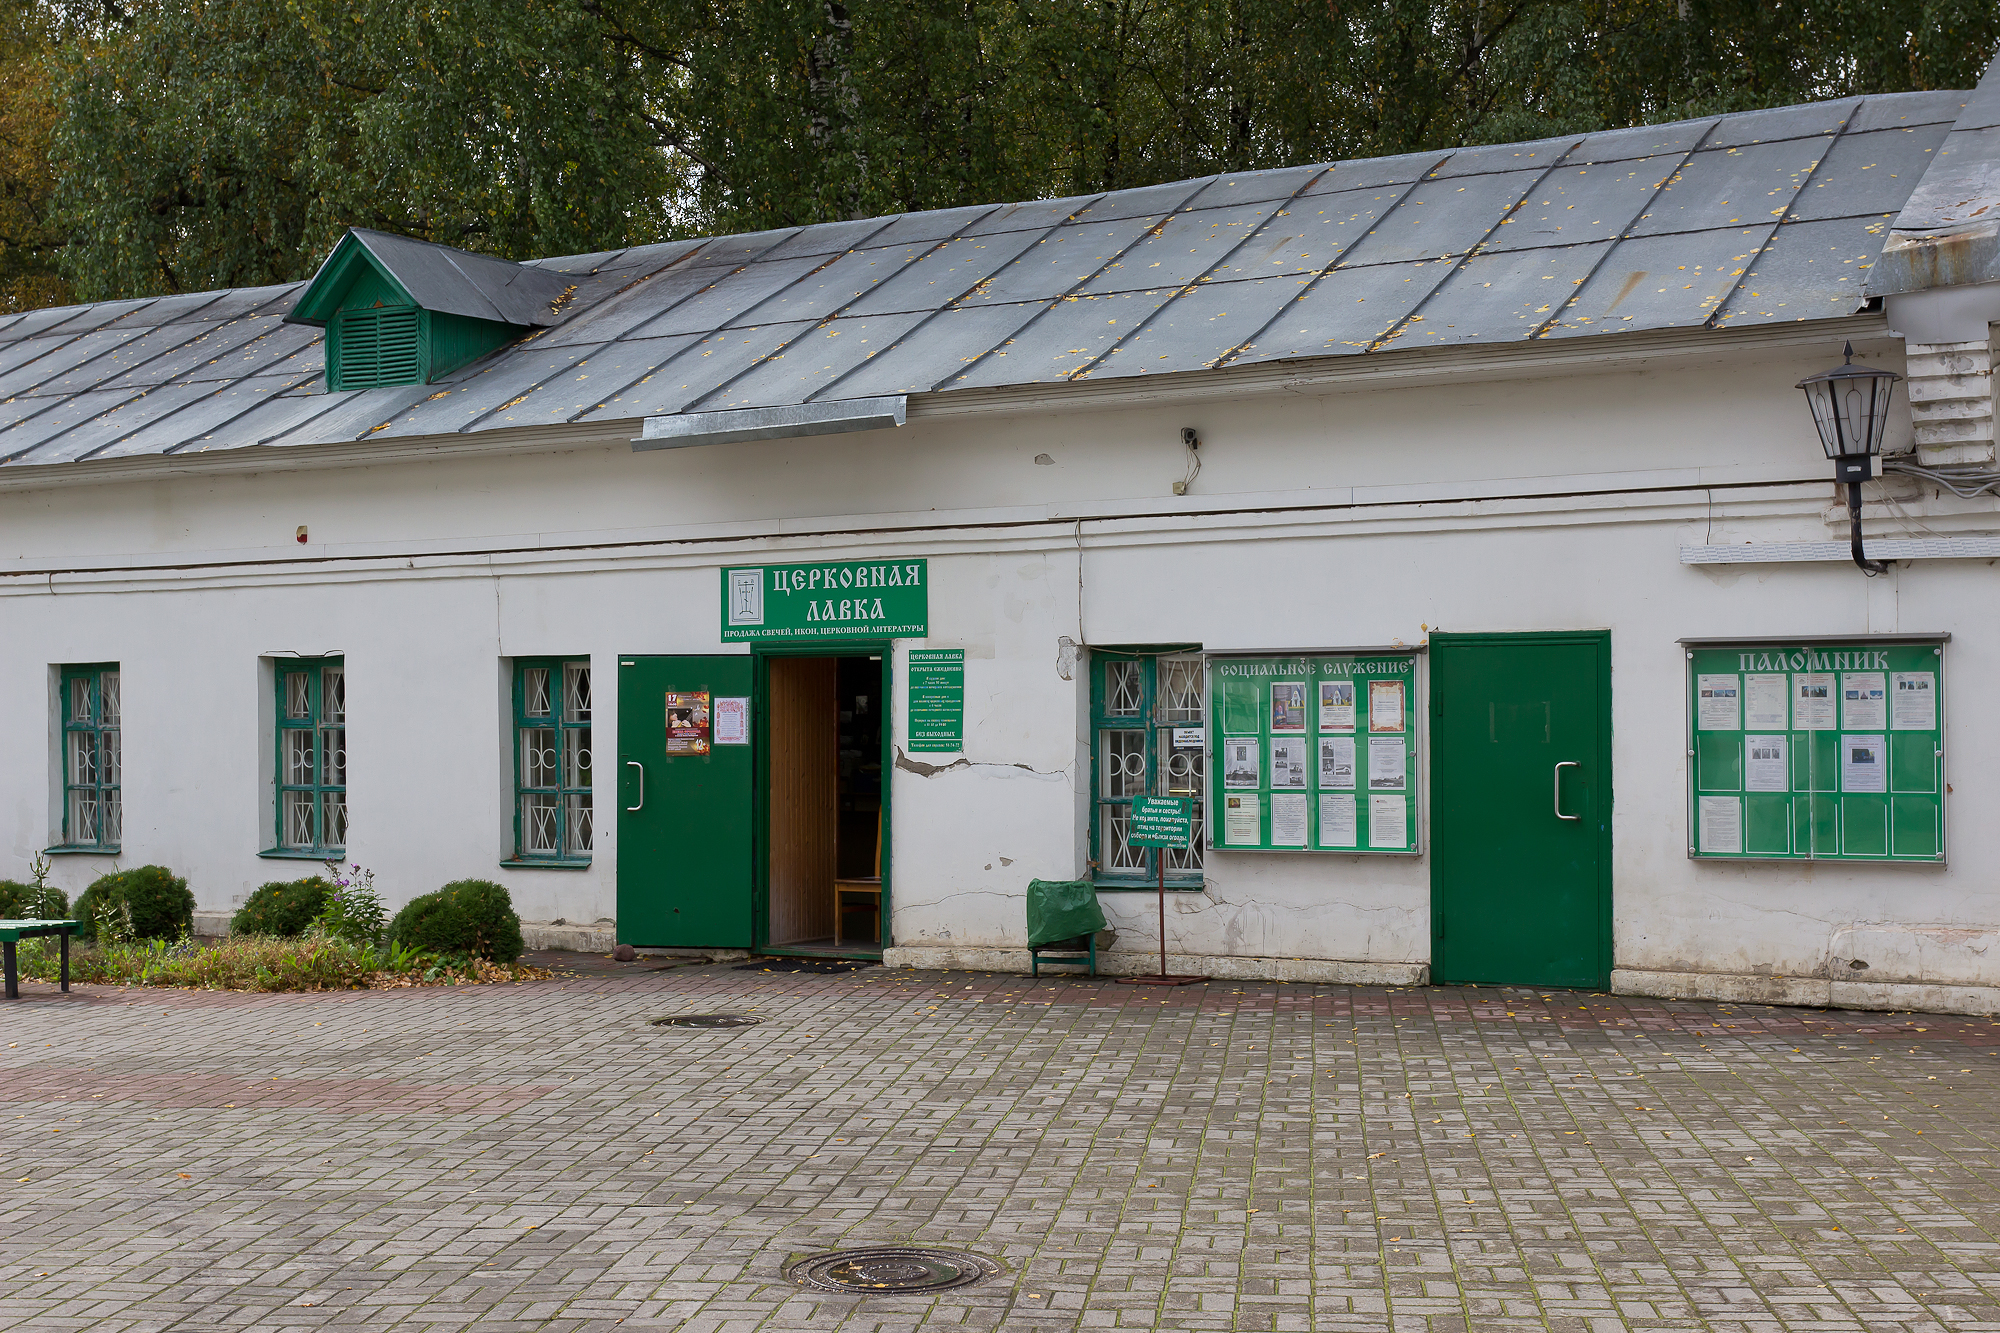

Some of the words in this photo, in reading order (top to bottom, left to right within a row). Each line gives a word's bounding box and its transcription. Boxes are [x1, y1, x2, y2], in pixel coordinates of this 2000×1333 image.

[773, 564, 920, 596] ЦЕРКОВНАЯ
[806, 598, 886, 622] ЛАВКА
[724, 629, 761, 638] ПРОДАЖА
[761, 627, 793, 637] СВЕЧЕЙ,
[794, 627, 819, 636] ИКОН,
[820, 625, 869, 636] ЦЕРКОВНОЙ
[870, 624, 924, 634] ЛИТЕРАТУРЫ
[1220, 661, 1317, 678] СОЦИАЛЬНОЕ
[1323, 660, 1410, 678] СЛУЖЕНИЕ
[1738, 651, 1890, 671] ПАЛОМНИК
[1141, 806, 1158, 814] братья
[1147, 797, 1179, 806] Уважаемые
